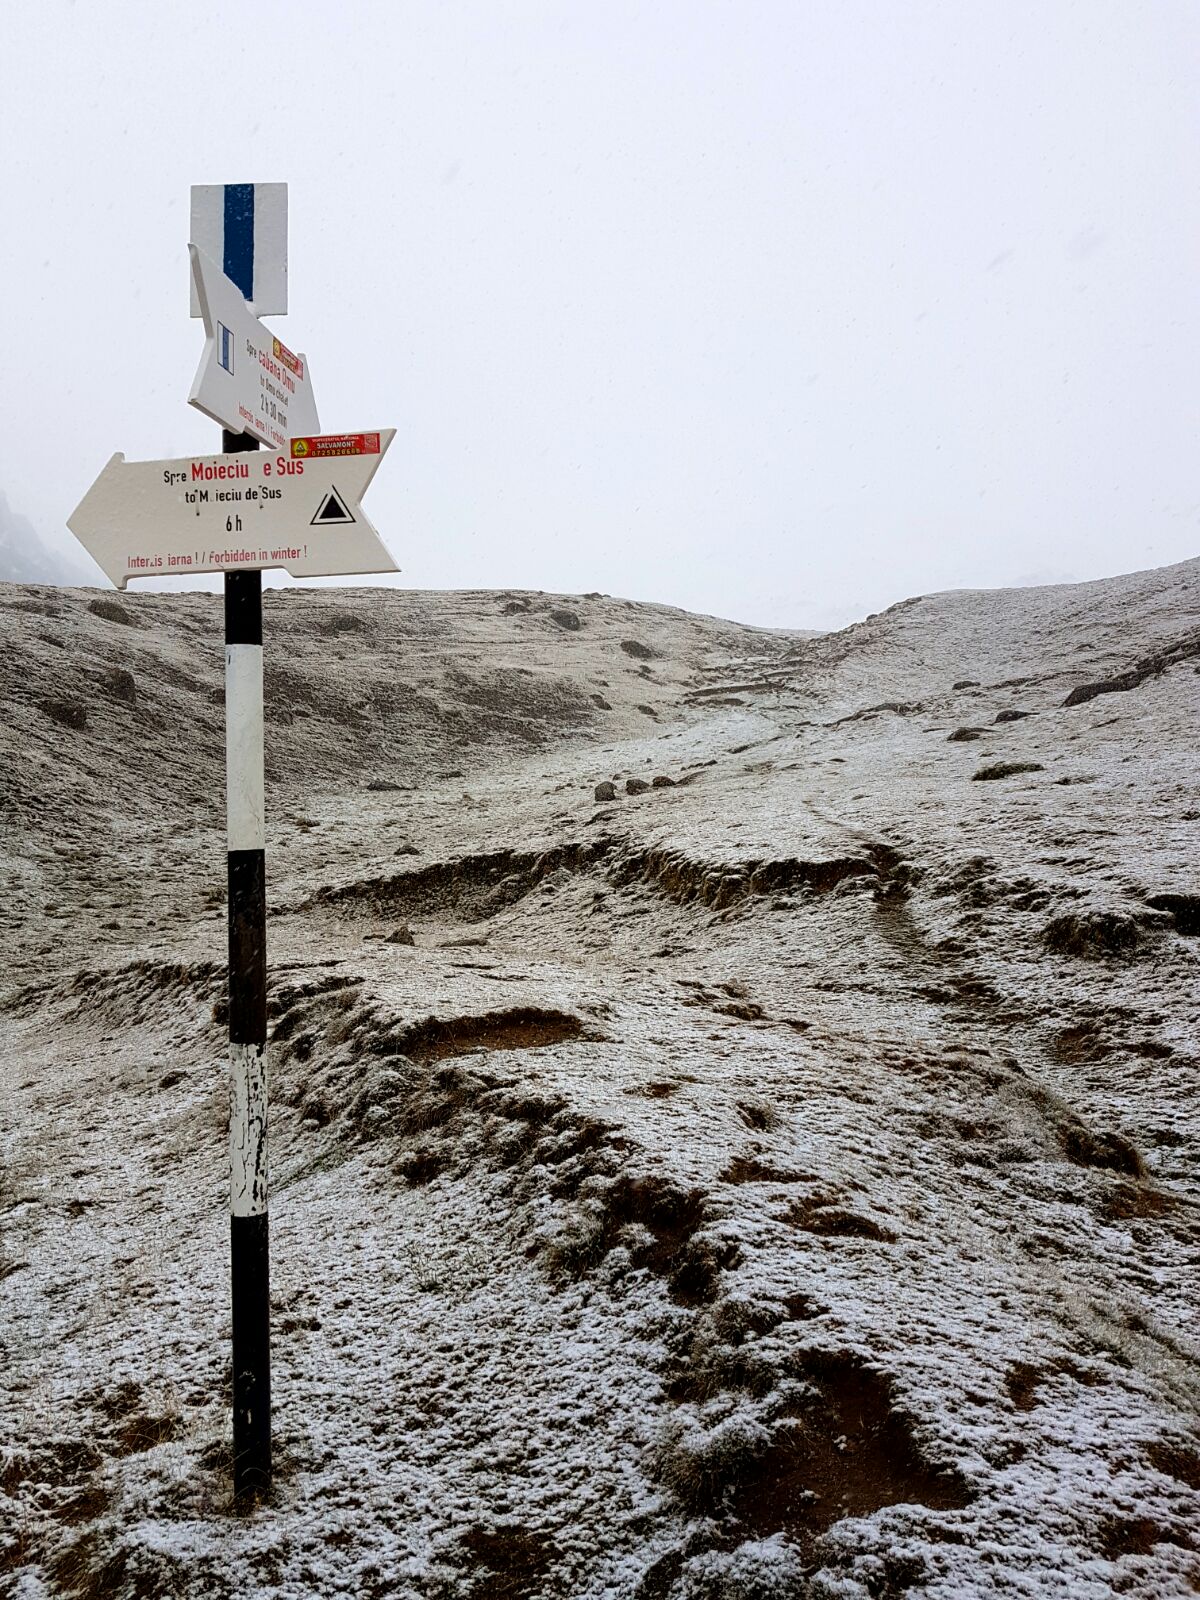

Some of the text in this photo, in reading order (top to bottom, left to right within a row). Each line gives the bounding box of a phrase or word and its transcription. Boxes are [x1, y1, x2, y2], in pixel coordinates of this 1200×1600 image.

[282, 368, 296, 394] Omu
[260, 394, 264, 412] 2
[265, 397, 269, 415] h
[270, 402, 277, 420] 30
[316, 441, 355, 449] SALVAMONT
[191, 460, 249, 481] Moieciu
[276, 456, 304, 476] Sus
[185, 486, 282, 503] to Mieciu de Sus
[226, 514, 242, 532] 6 h
[168, 554, 192, 566] iarna
[209, 548, 256, 564] Forbidden
[259, 548, 268, 560] in
[270, 546, 301, 560] winter
